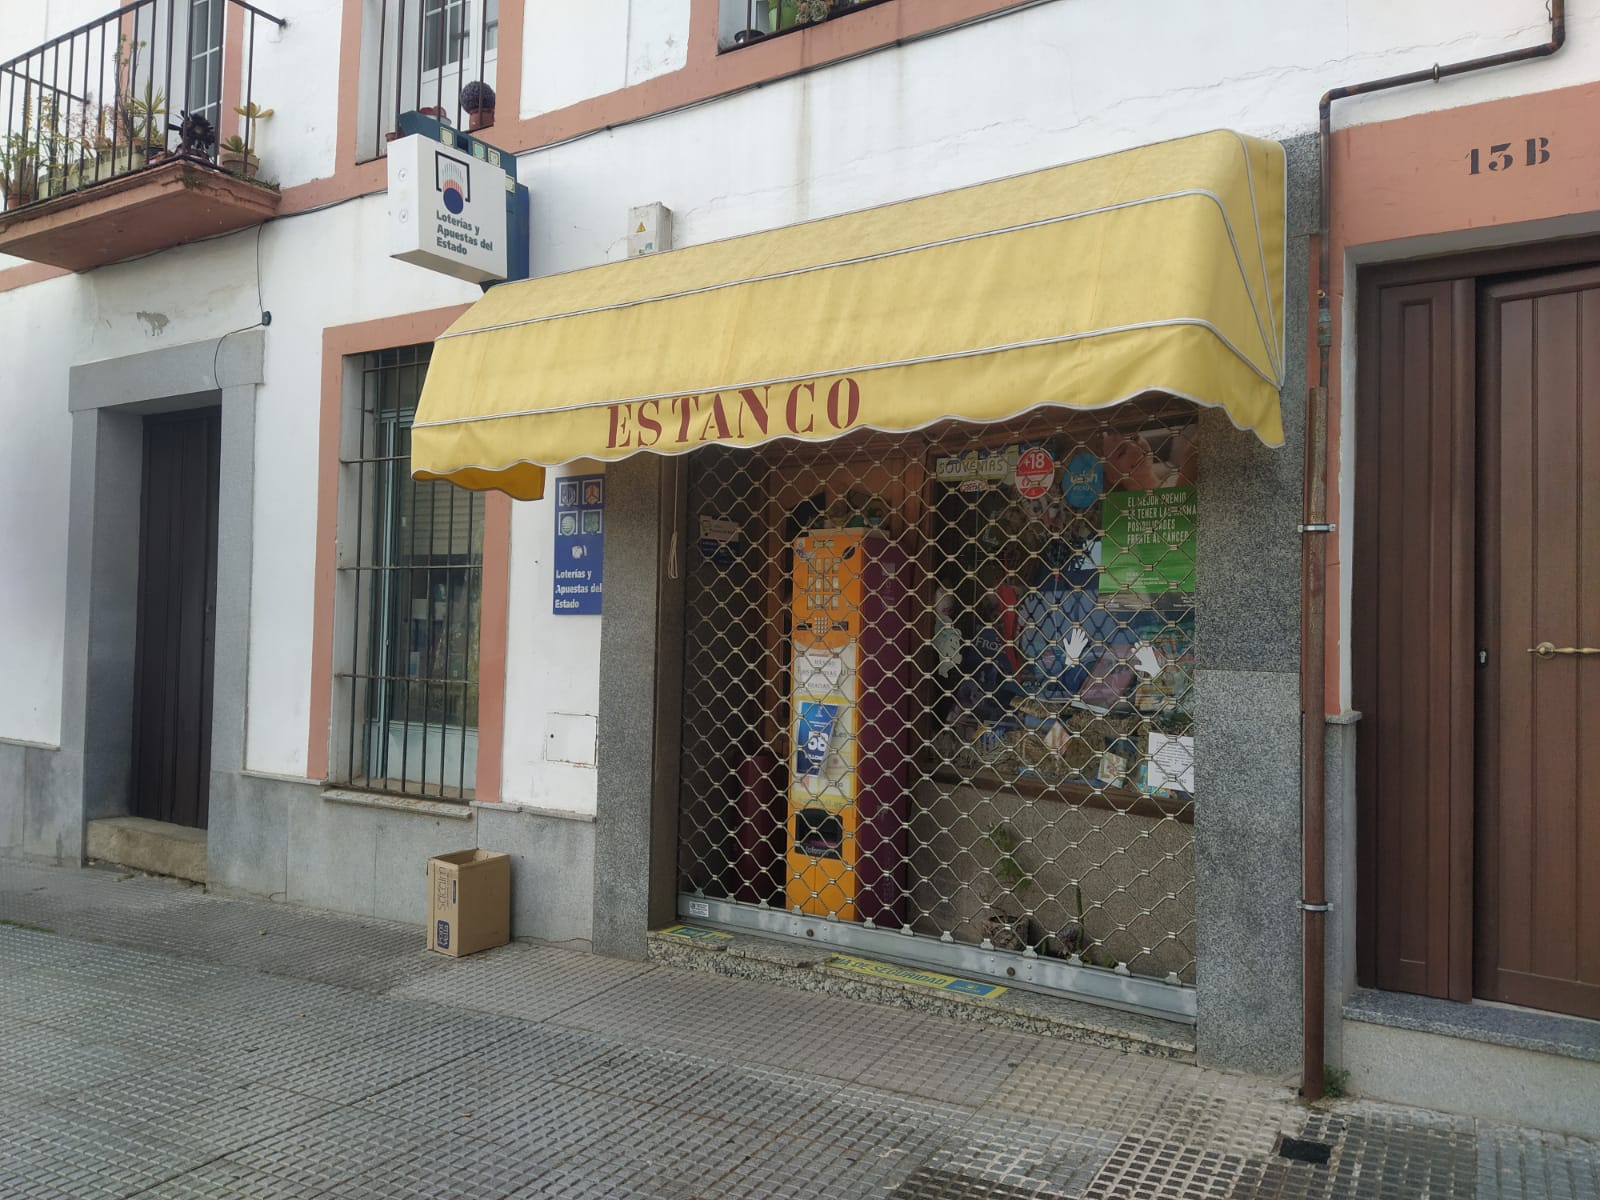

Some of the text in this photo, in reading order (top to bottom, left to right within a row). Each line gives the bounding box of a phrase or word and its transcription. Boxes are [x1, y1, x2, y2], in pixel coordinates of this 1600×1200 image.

[1525, 137, 1550, 166] B
[436, 210, 480, 236] Loterías y
[436, 237, 467, 255] Estado
[437, 224, 493, 251] Apuestas del
[606, 377, 861, 449] ESTANCO
[1024, 453, 1045, 470] +18
[1127, 496, 1135, 507] EL
[1137, 507, 1158, 519] TENER
[556, 569, 592, 581] Loterías y
[555, 583, 602, 595] Apuestas del
[555, 598, 580, 609] Estado
[852, 961, 870, 970] DE
[872, 965, 948, 985] SEGURIDAD
